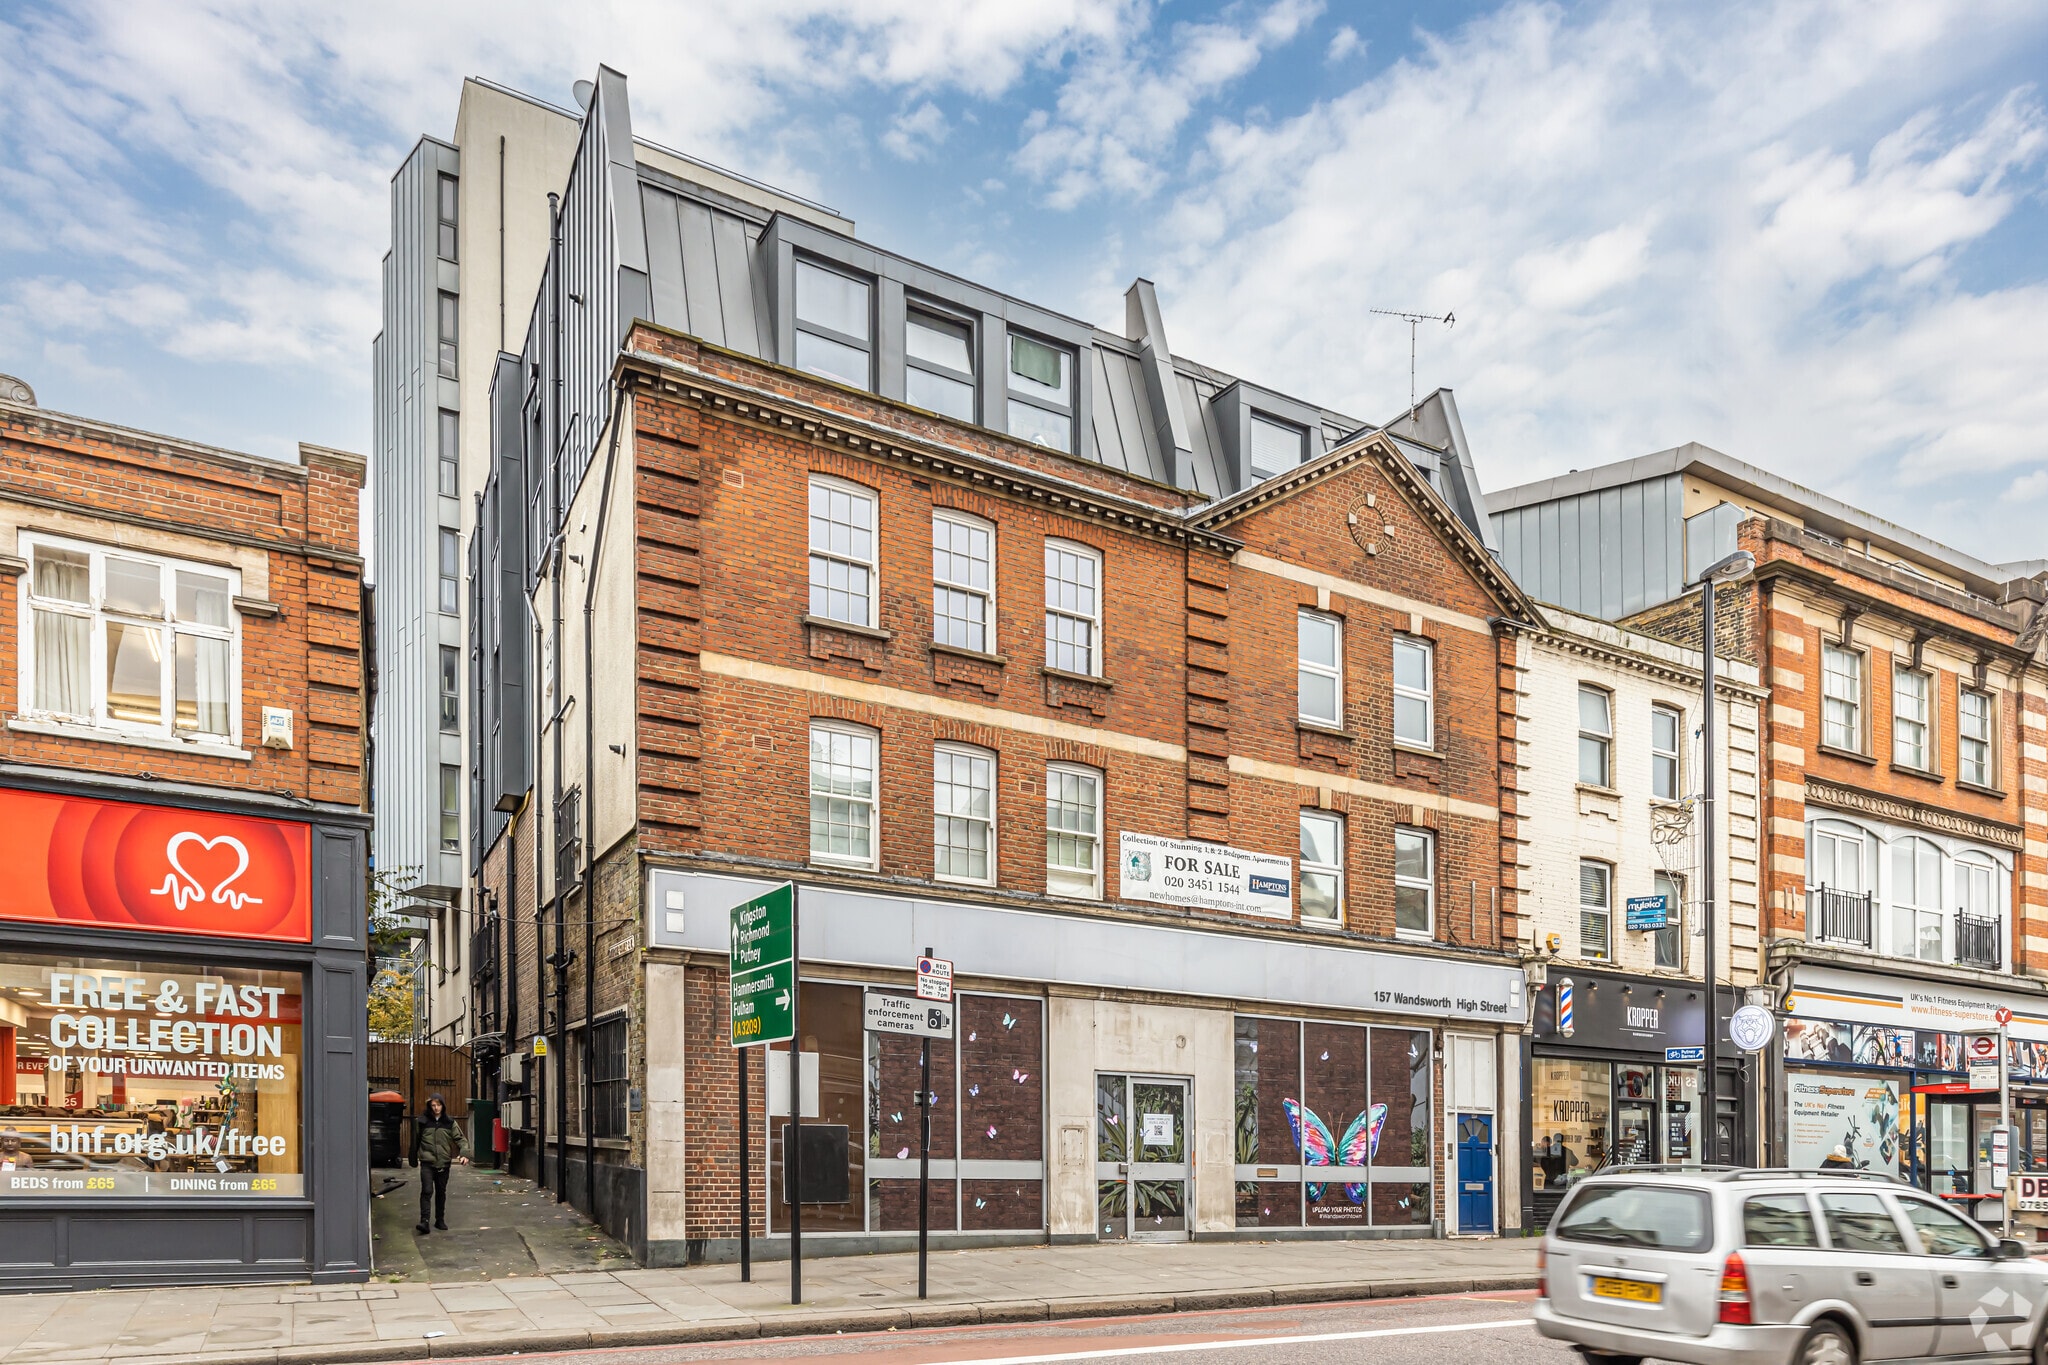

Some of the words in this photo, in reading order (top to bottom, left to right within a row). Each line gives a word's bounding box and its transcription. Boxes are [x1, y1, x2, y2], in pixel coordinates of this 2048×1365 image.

[1122, 834, 1158, 846] Collection
[1160, 840, 1169, 848] Of
[1170, 842, 1202, 853] Stunning
[1223, 850, 1251, 861] Bedroom
[1252, 855, 1290, 867] Apartments
[1164, 855, 1199, 873] FOR
[1204, 860, 1241, 879] SALE
[1164, 875, 1184, 888] 020
[1188, 878, 1213, 892] 3451
[1218, 882, 1240, 895] 1544
[1149, 891, 1262, 913] newhomes@hamptons-int.com
[739, 905, 767, 926] Kingston
[740, 921, 770, 945] Richmond
[740, 947, 761, 965] Putney
[928, 979, 950, 988] stopping
[932, 969, 950, 977] ROUTE
[51, 973, 146, 1011] FREE
[154, 980, 188, 1013] &
[195, 982, 285, 1018] FAST
[733, 973, 775, 998] Hammersmith
[733, 1002, 755, 1017] Fulham
[881, 998, 911, 1009] Traffic
[1374, 991, 1391, 1003] 157
[1394, 992, 1452, 1008] Wandsworth
[1456, 998, 1478, 1012] High
[1480, 1000, 1508, 1014] Street
[1910, 993, 1923, 1002] UK's
[1924, 995, 1937, 1003] No.1
[1938, 997, 1957, 1006] Fitness
[1957, 999, 1986, 1010] Equipment
[867, 1008, 924, 1021] enforcement
[877, 1020, 914, 1030] cameras
[1626, 1006, 1659, 1029] KROPPER
[1998, 1010, 2009, 1021] Y
[50, 1014, 281, 1058] COLLECTION
[733, 1016, 761, 1038] (A3209)
[48, 1055, 73, 1072] OF
[76, 1056, 127, 1074] YOUR
[130, 1057, 229, 1079] UNWANTED
[232, 1062, 285, 1081] ITEMS
[1553, 1100, 1590, 1122] KROPPER
[50, 1124, 286, 1161] bhf.org.uk/free
[10, 1177, 49, 1190] BEDS
[52, 1177, 84, 1190] from
[86, 1178, 115, 1190] £65
[170, 1178, 217, 1191] DINING
[220, 1179, 248, 1192] from
[251, 1179, 277, 1191] £65
